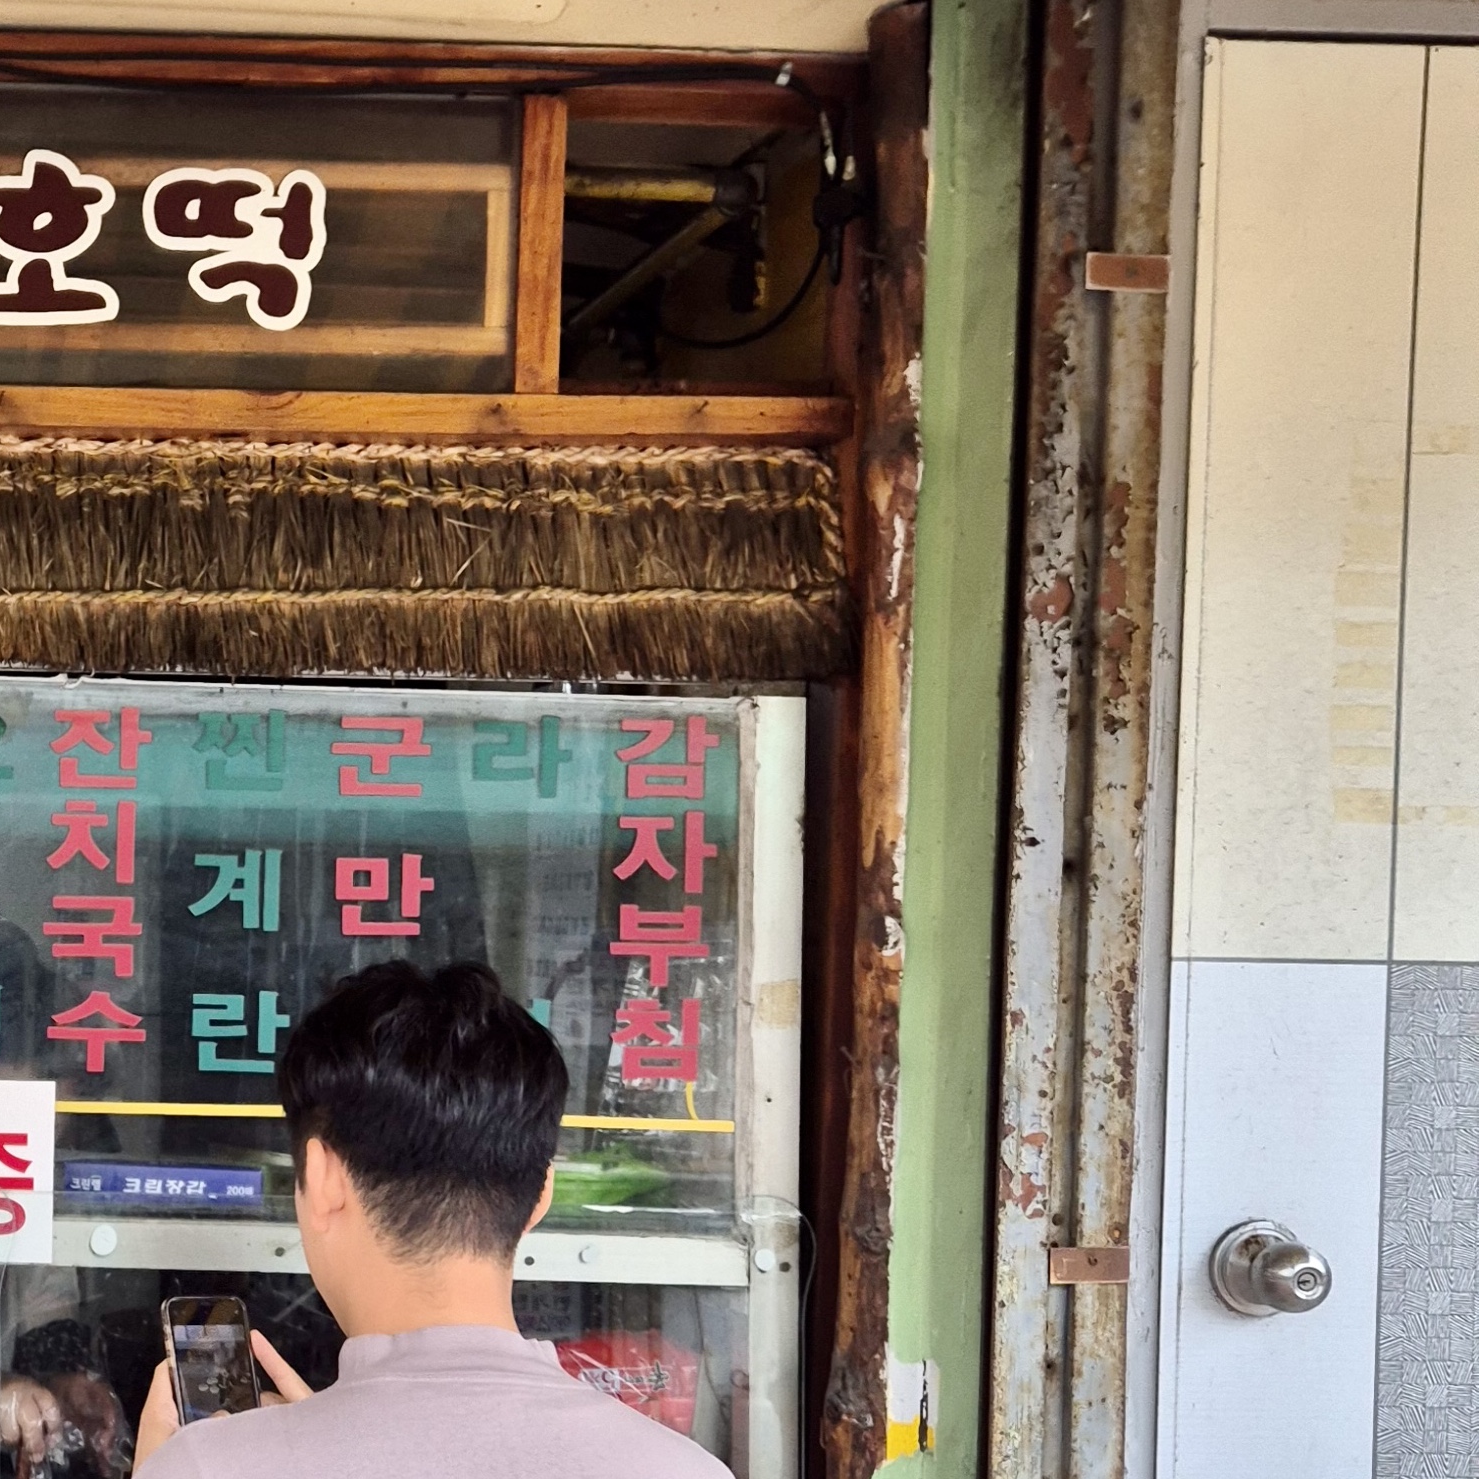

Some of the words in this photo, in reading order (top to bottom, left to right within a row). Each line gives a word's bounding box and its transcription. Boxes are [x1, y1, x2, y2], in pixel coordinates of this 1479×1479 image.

[42, 707, 152, 1072] 잔치국수
[331, 716, 434, 936] 군만
[609, 715, 720, 1082] 감자부침
